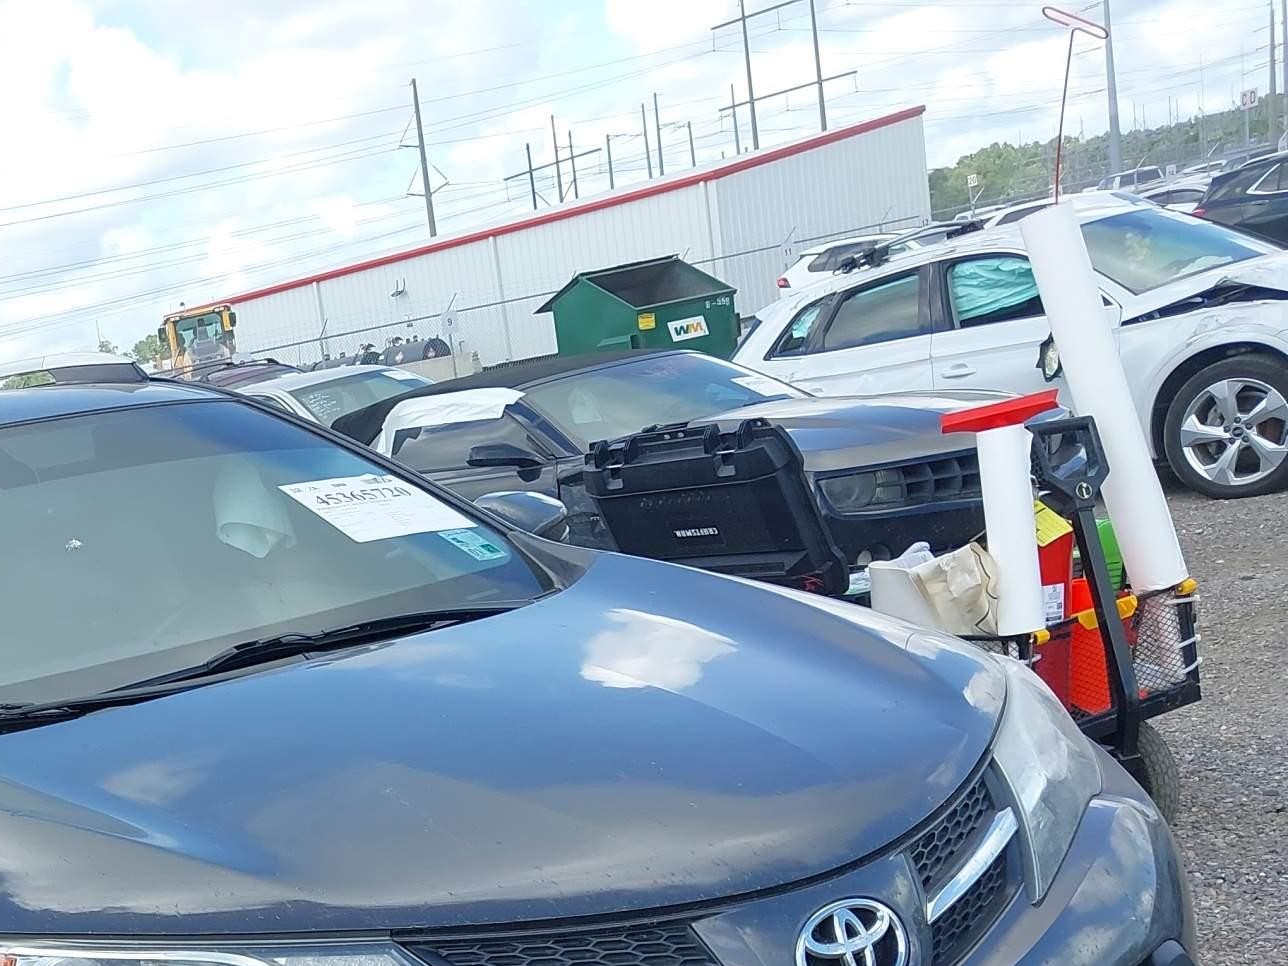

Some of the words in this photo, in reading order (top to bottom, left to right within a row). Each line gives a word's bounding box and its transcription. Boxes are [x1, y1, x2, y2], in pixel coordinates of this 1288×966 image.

[785, 248, 792, 256] 11
[674, 322, 704, 336] WM
[316, 487, 412, 506] 45365720
[673, 527, 719, 537] CRAFTSMAN
